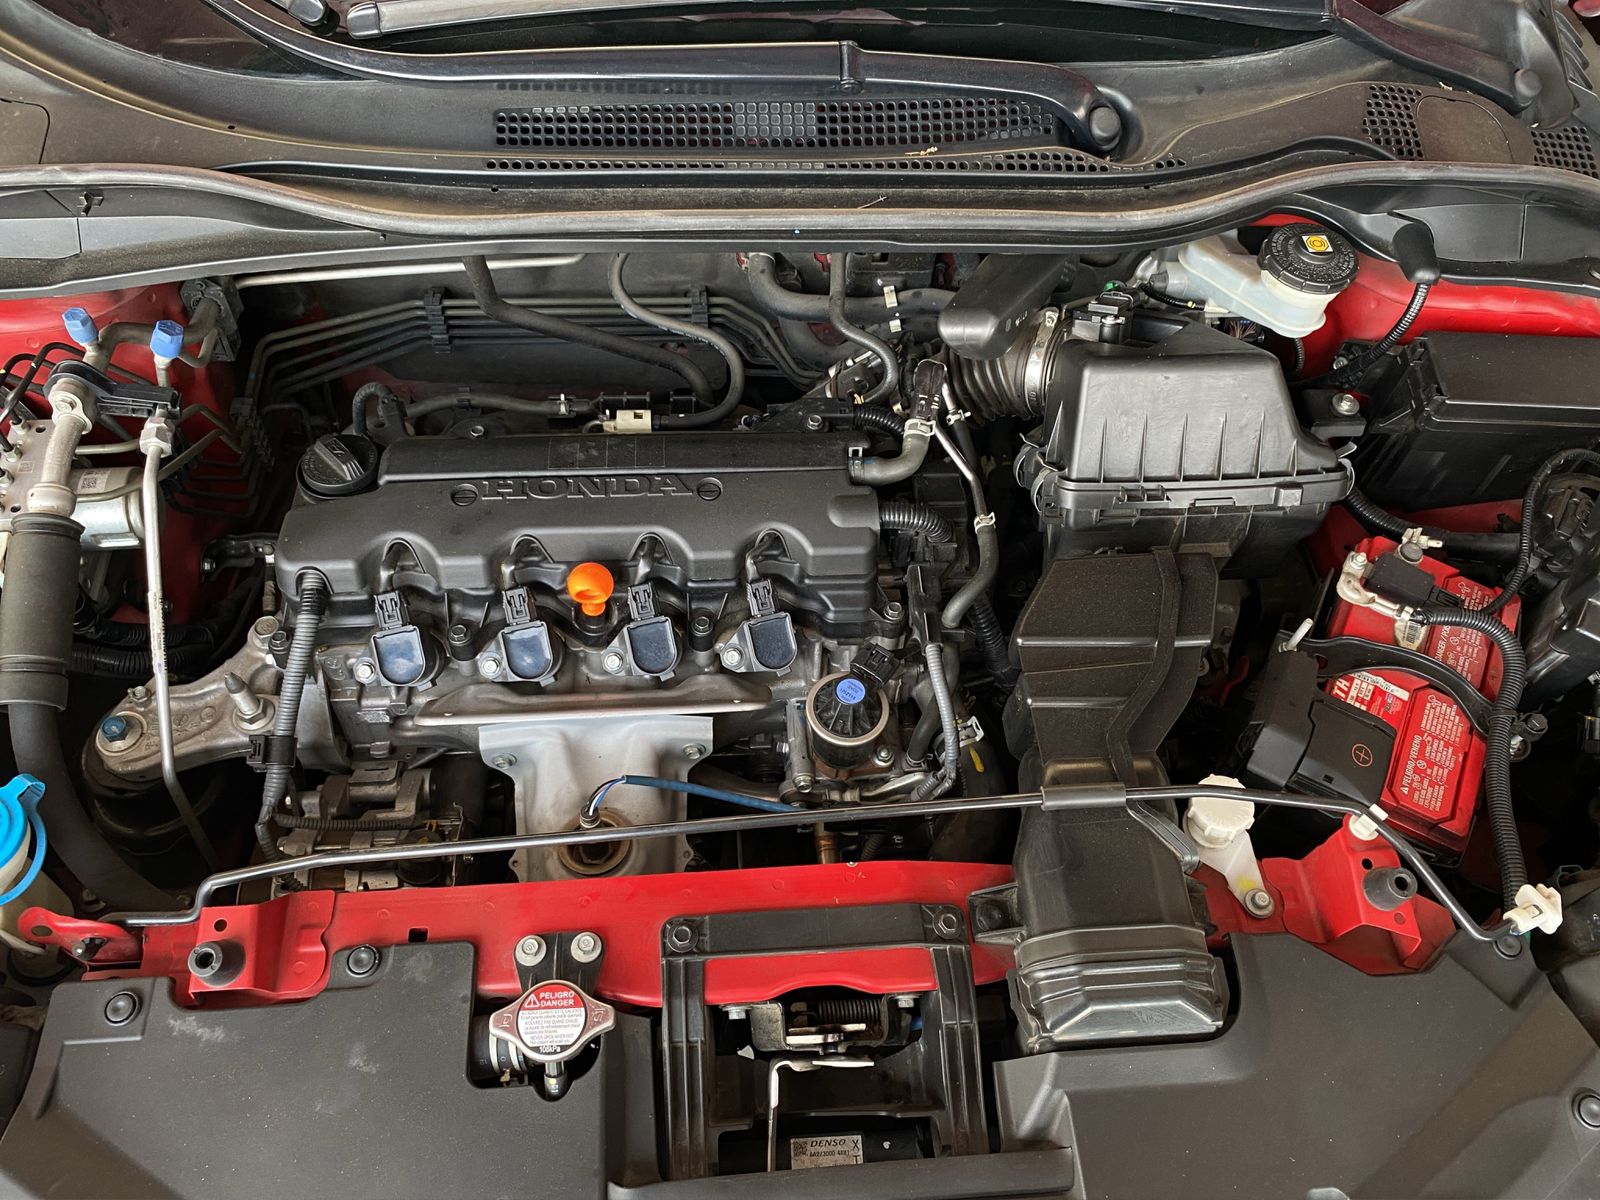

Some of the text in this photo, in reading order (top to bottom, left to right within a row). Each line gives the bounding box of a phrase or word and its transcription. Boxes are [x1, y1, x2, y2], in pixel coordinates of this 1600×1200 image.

[482, 474, 692, 500] HONDA
[540, 991, 575, 999] PELIGRO
[540, 999, 574, 1007] DANGER
[810, 1138, 846, 1148] DENSO
